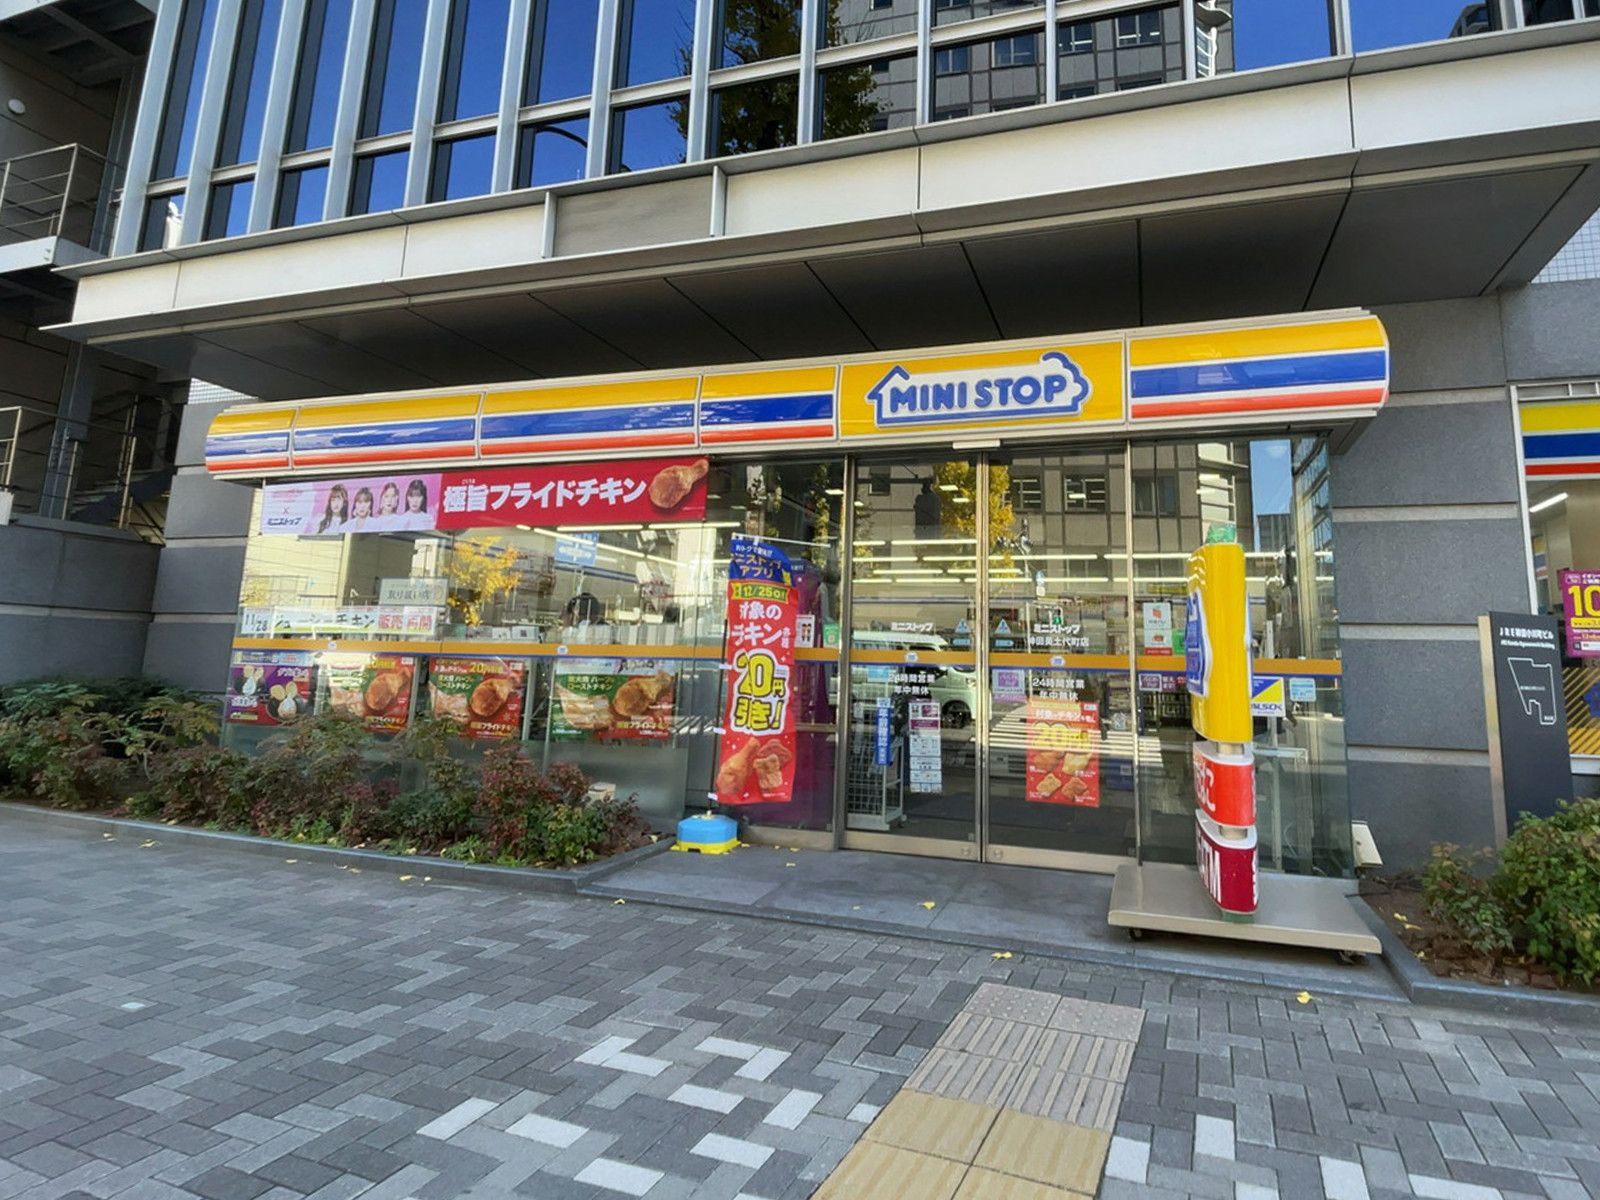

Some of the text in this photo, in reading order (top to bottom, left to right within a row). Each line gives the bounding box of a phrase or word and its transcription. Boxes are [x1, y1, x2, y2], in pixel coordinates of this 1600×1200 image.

[890, 374, 1067, 413] MINI STOP
[443, 477, 647, 513] 極旨フライドチキン
[267, 517, 302, 526] ミニストップ
[740, 565, 773, 578] アプリ
[891, 622, 934, 632] ミニストップ
[1033, 623, 1081, 634] ミニストップ
[732, 622, 783, 646] チキン
[889, 673, 935, 684] 24時間営業
[1032, 678, 1085, 689] 24時間営業
[894, 685, 929, 695] 年中無休
[1039, 690, 1078, 700] 年中無休
